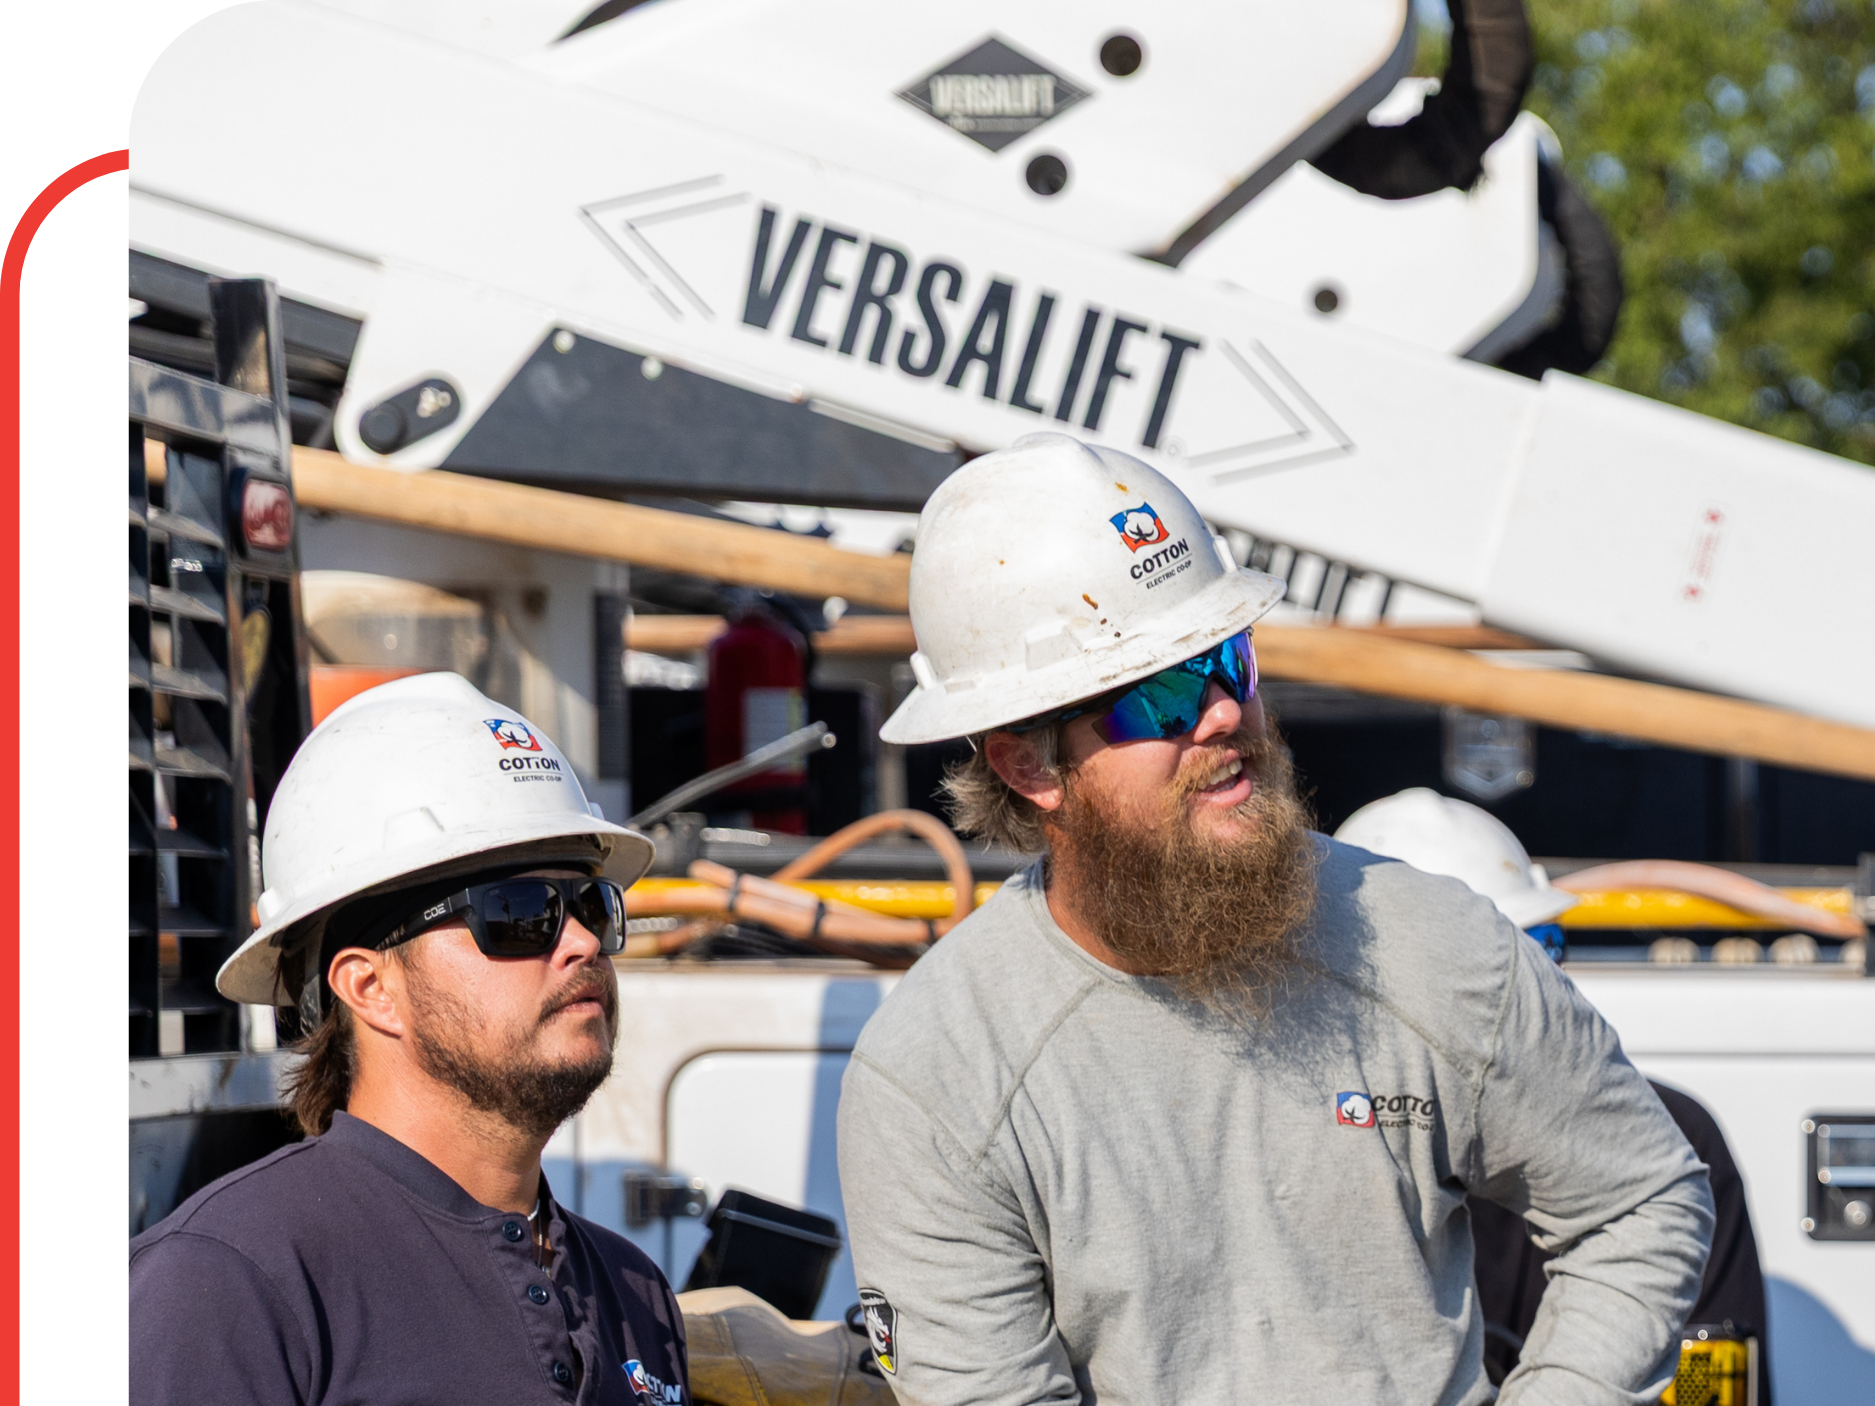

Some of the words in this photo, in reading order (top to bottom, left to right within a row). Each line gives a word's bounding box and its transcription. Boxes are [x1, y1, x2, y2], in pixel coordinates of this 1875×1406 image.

[741, 206, 1204, 449] VERSALIFT
[1130, 538, 1189, 579] COTTON
[1146, 569, 1176, 589] ELECTRIC
[1371, 1095, 1436, 1116] COTTO
